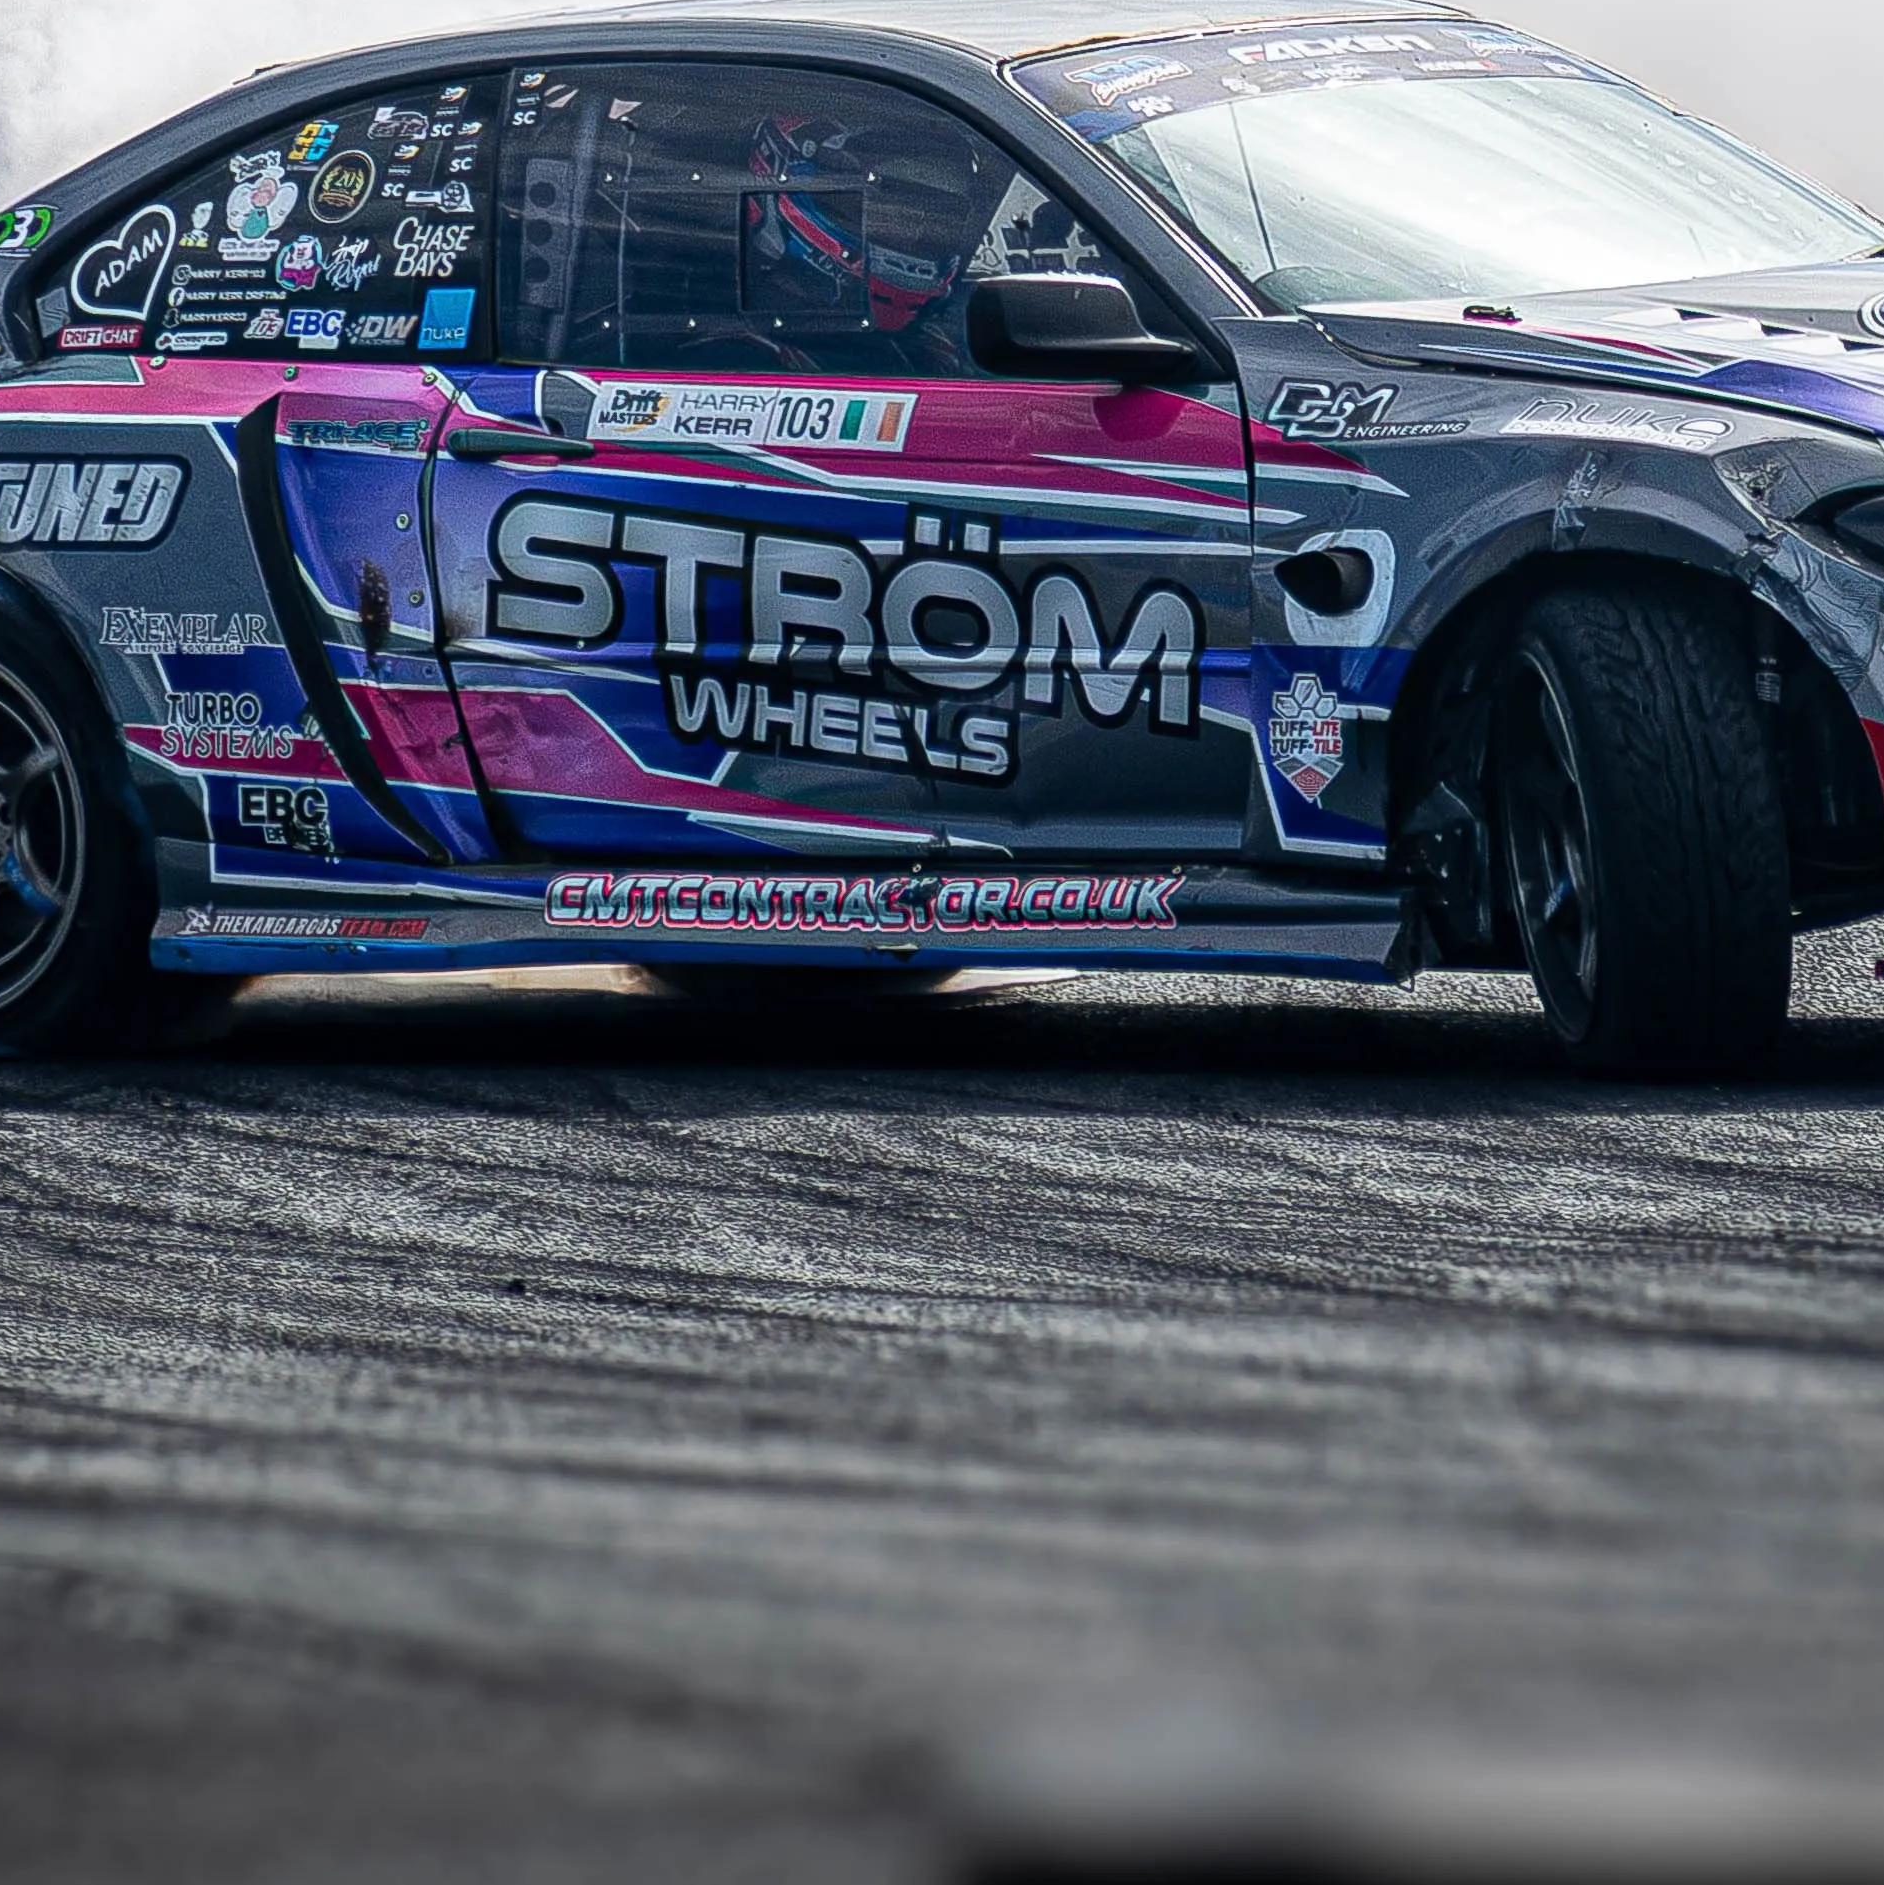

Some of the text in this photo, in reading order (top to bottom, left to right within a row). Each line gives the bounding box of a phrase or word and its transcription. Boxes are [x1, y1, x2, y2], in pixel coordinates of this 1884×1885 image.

[430, 123, 454, 137] SC
[512, 111, 536, 126] SC
[449, 157, 473, 172] SC
[381, 183, 405, 197] SC
[95, 228, 164, 298] ADAM
[287, 310, 343, 336] EBC
[361, 315, 418, 338] DW
[423, 327, 465, 341] nuke
[612, 389, 660, 412] Drift
[680, 393, 775, 413] HARRY
[673, 416, 752, 437] KERR
[776, 396, 833, 439] 103
[1344, 422, 1466, 438] ENGINEERING
[101, 607, 267, 645] EXEMPLAR
[496, 509, 1193, 728] STRÖM
[167, 694, 262, 724] TURBO
[670, 674, 1009, 776] WHEELS
[161, 726, 293, 758] SYSTEMS
[241, 786, 329, 825] EBC
